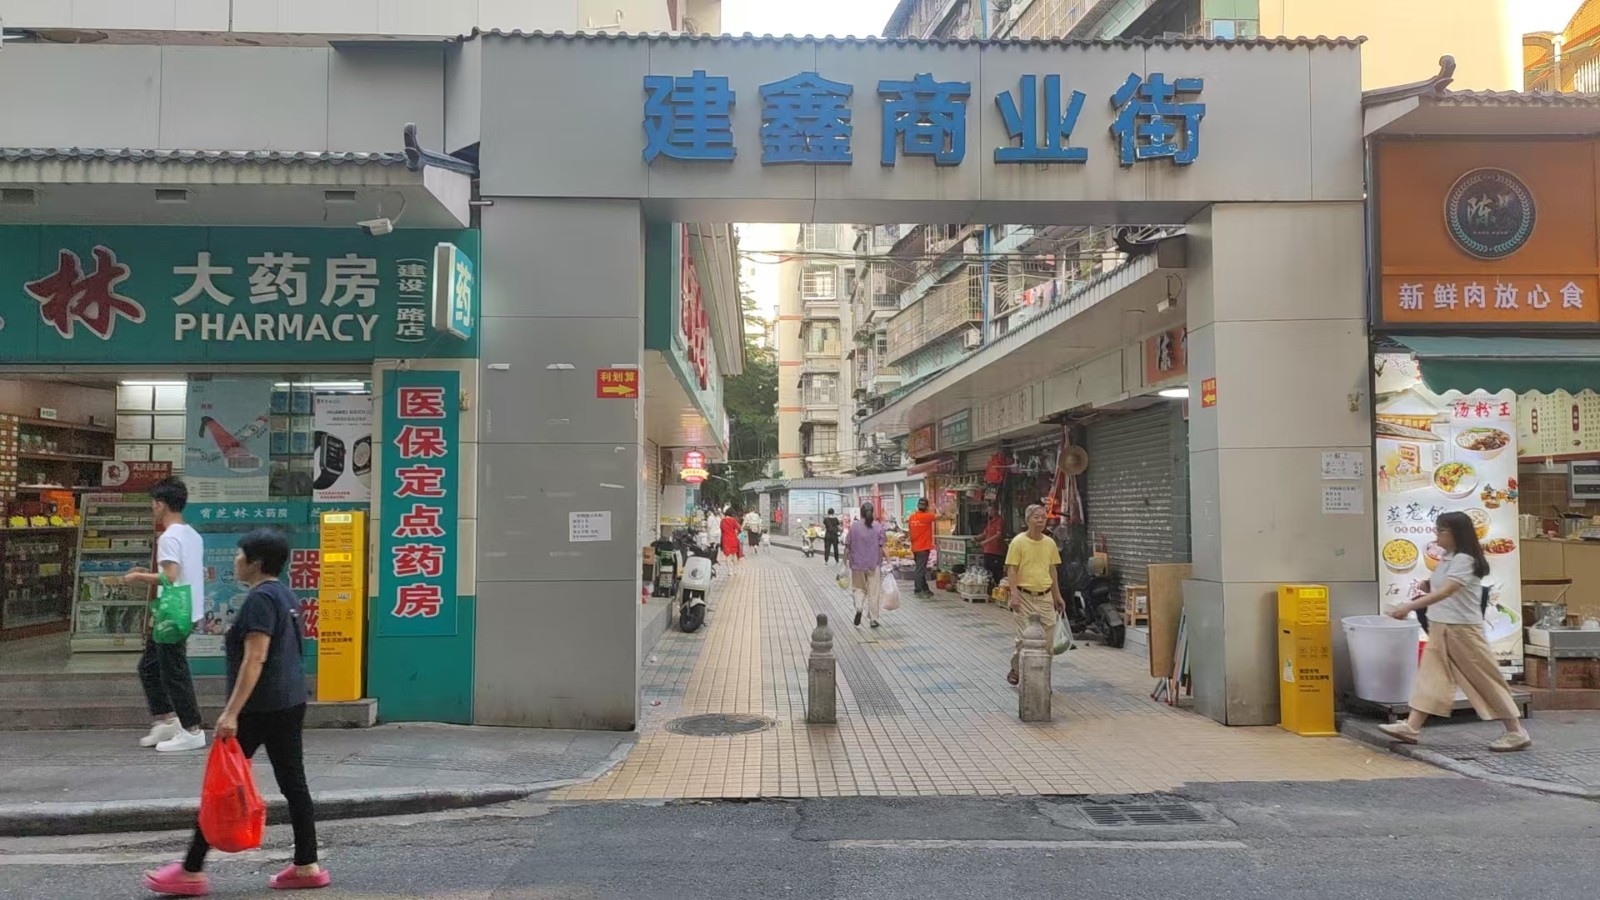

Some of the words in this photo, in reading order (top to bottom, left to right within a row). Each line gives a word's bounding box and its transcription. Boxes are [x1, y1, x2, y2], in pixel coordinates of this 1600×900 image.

[642, 70, 1207, 167] 建鑫商业街
[24, 245, 146, 340] 林
[172, 252, 380, 307] 大药房
[456, 262, 474, 327] 药
[1398, 282, 1585, 310] 新鲜肉放心食
[174, 313, 380, 342] PHARMACY
[1453, 402, 1511, 418] 汤粉王
[391, 387, 448, 618] 医保定点药房
